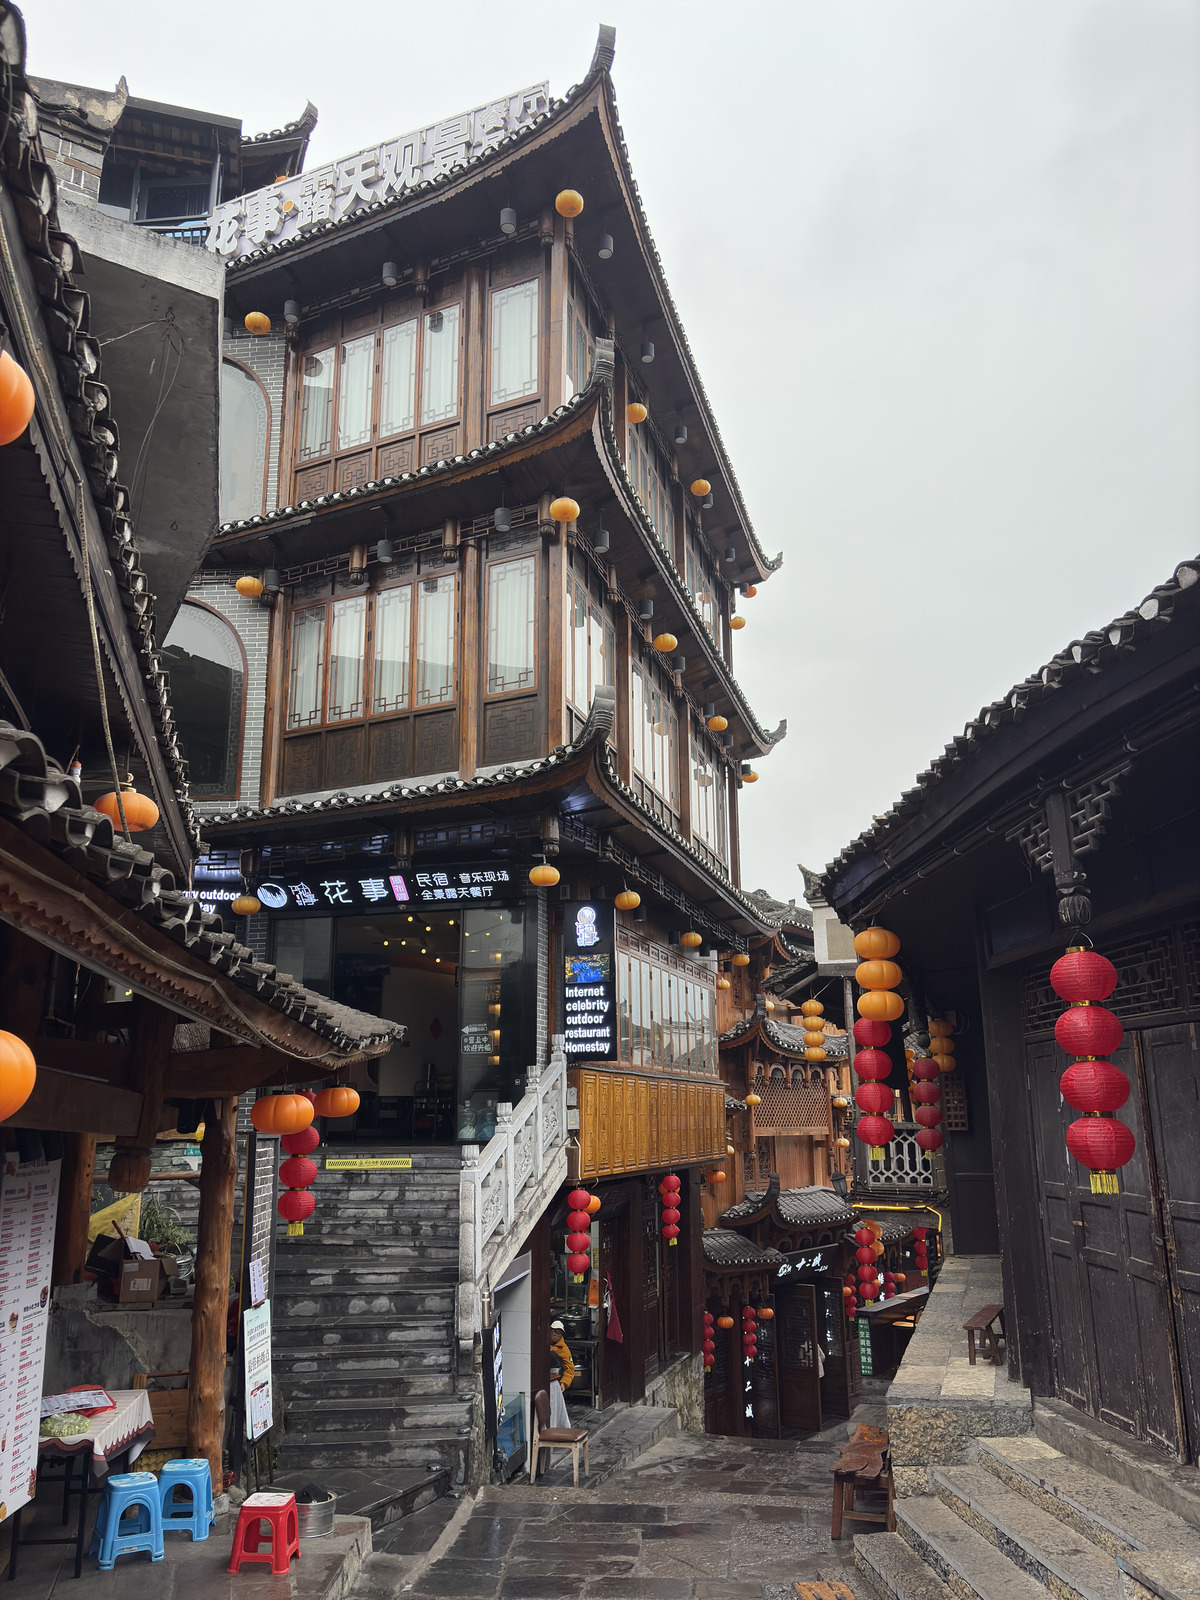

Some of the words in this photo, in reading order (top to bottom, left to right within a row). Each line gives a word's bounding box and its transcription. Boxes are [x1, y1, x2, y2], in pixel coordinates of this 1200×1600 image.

[199, 887, 241, 900] outdoor
[565, 986, 604, 998] Internet
[565, 1000, 609, 1012] celebrity
[566, 1013, 604, 1025] outdoor
[565, 1027, 610, 1039] restaurant
[565, 1041, 610, 1054] Homestay
